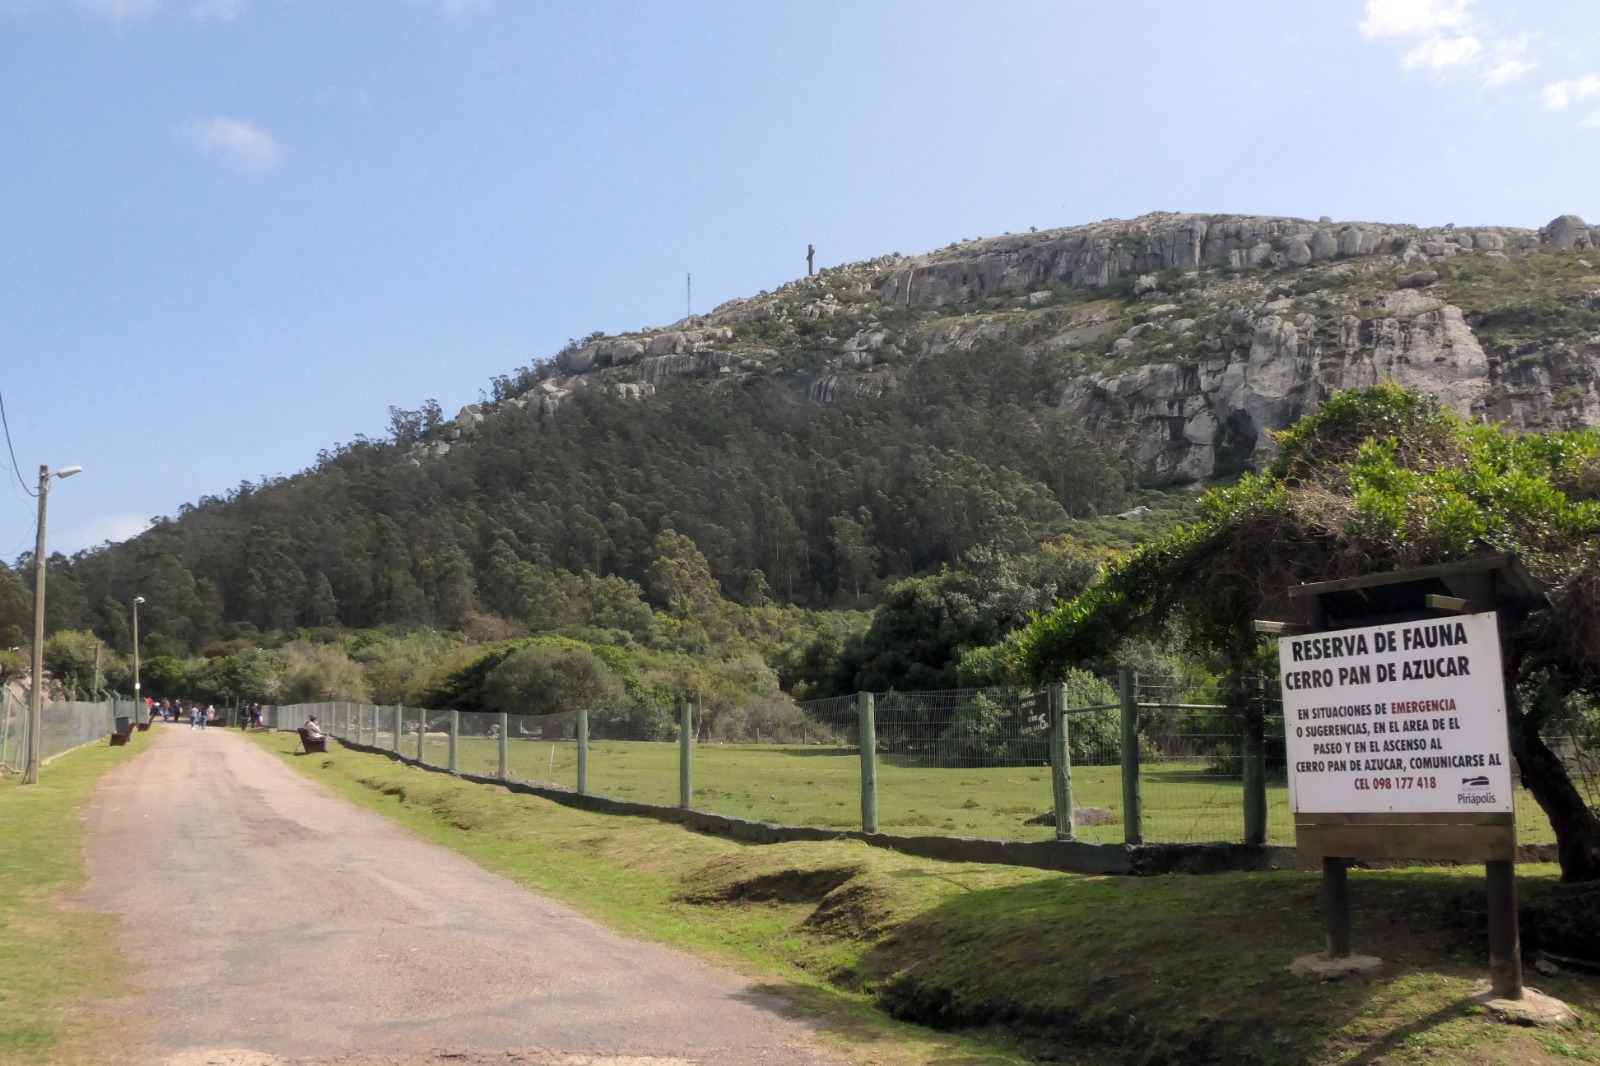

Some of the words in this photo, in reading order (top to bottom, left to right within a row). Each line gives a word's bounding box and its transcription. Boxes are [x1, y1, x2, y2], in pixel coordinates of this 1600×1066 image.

[1292, 634, 1369, 662] RESERVA
[1374, 631, 1397, 653] DE
[1403, 622, 1468, 650] FAUNA
[1285, 668, 1333, 690] CERRO
[1338, 665, 1371, 686] PAN
[1376, 663, 1397, 683] DE
[1402, 656, 1470, 680] AZUCAR
[1298, 709, 1309, 720] EN
[1312, 704, 1371, 719] SITUACIONES
[1374, 703, 1387, 715] DE
[1391, 699, 1456, 714] EMERGENCIA
[1296, 727, 1303, 738] O
[1305, 723, 1371, 737] SUGERENCIAS,
[1373, 722, 1385, 734] EN
[1389, 721, 1399, 732] EL
[1403, 719, 1429, 732] AREA
[1432, 718, 1445, 730] DE
[1448, 717, 1460, 729] EL
[1313, 742, 1342, 754] PASEO
[1345, 742, 1351, 753] Y
[1354, 741, 1366, 753] EN
[1369, 741, 1380, 752] EL
[1383, 739, 1426, 752] ASCENSO
[1430, 738, 1442, 750] AL
[1296, 761, 1324, 773] CERRO
[1327, 760, 1346, 772] PAN
[1349, 759, 1361, 771] DE
[1364, 758, 1406, 772] AZUCAR,
[1409, 754, 1485, 769] COMUNICARSE
[1488, 753, 1501, 766] AL
[1354, 778, 1370, 790] CEL
[1372, 777, 1392, 789] 098
[1395, 777, 1413, 789] 177
[1416, 776, 1437, 789] 418
[1457, 792, 1496, 806] Piriápolis
